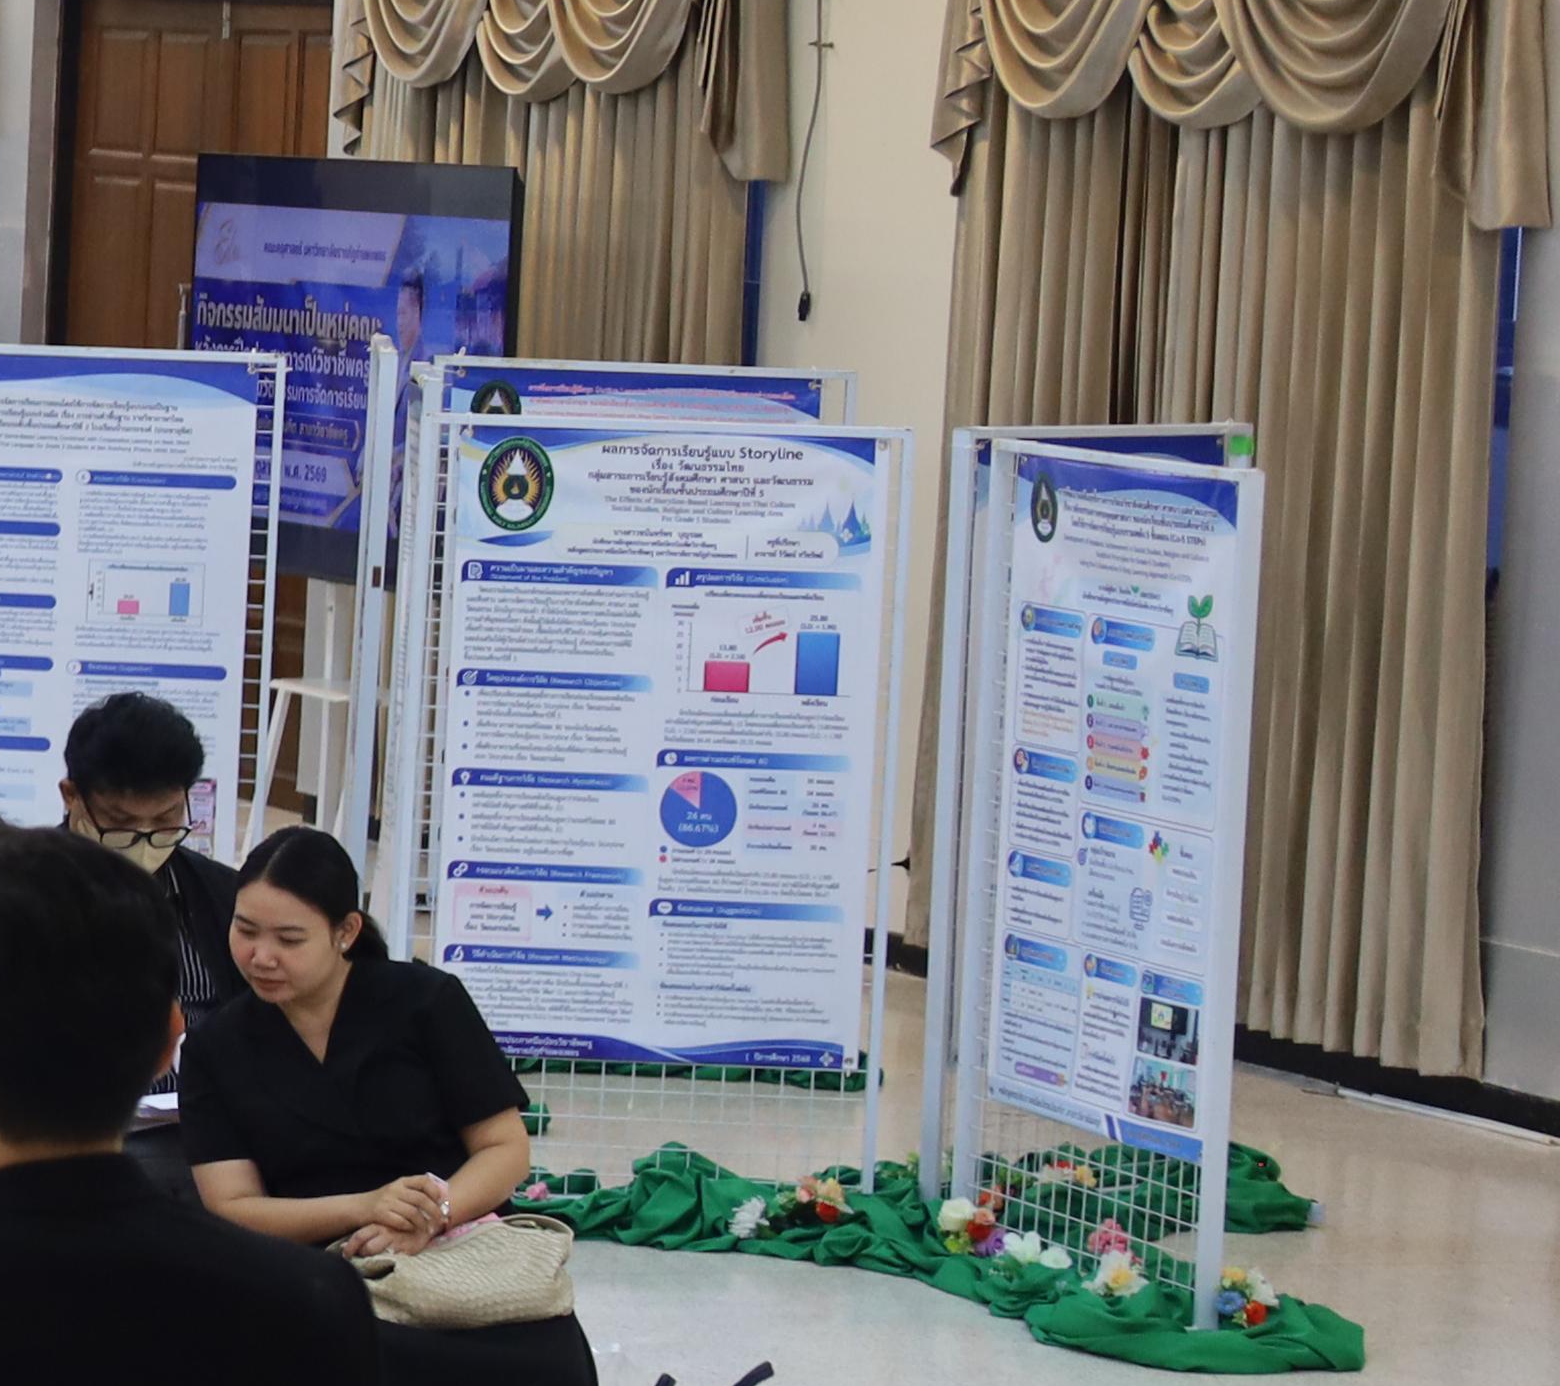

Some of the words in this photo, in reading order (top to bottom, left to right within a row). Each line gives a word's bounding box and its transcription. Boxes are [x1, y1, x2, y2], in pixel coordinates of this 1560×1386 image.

[601, 444, 735, 461] ผลการจัดการเรียนรู้แบบ
[739, 447, 804, 463] Storyline
[677, 459, 745, 473] วัฒนธรรมไทย
